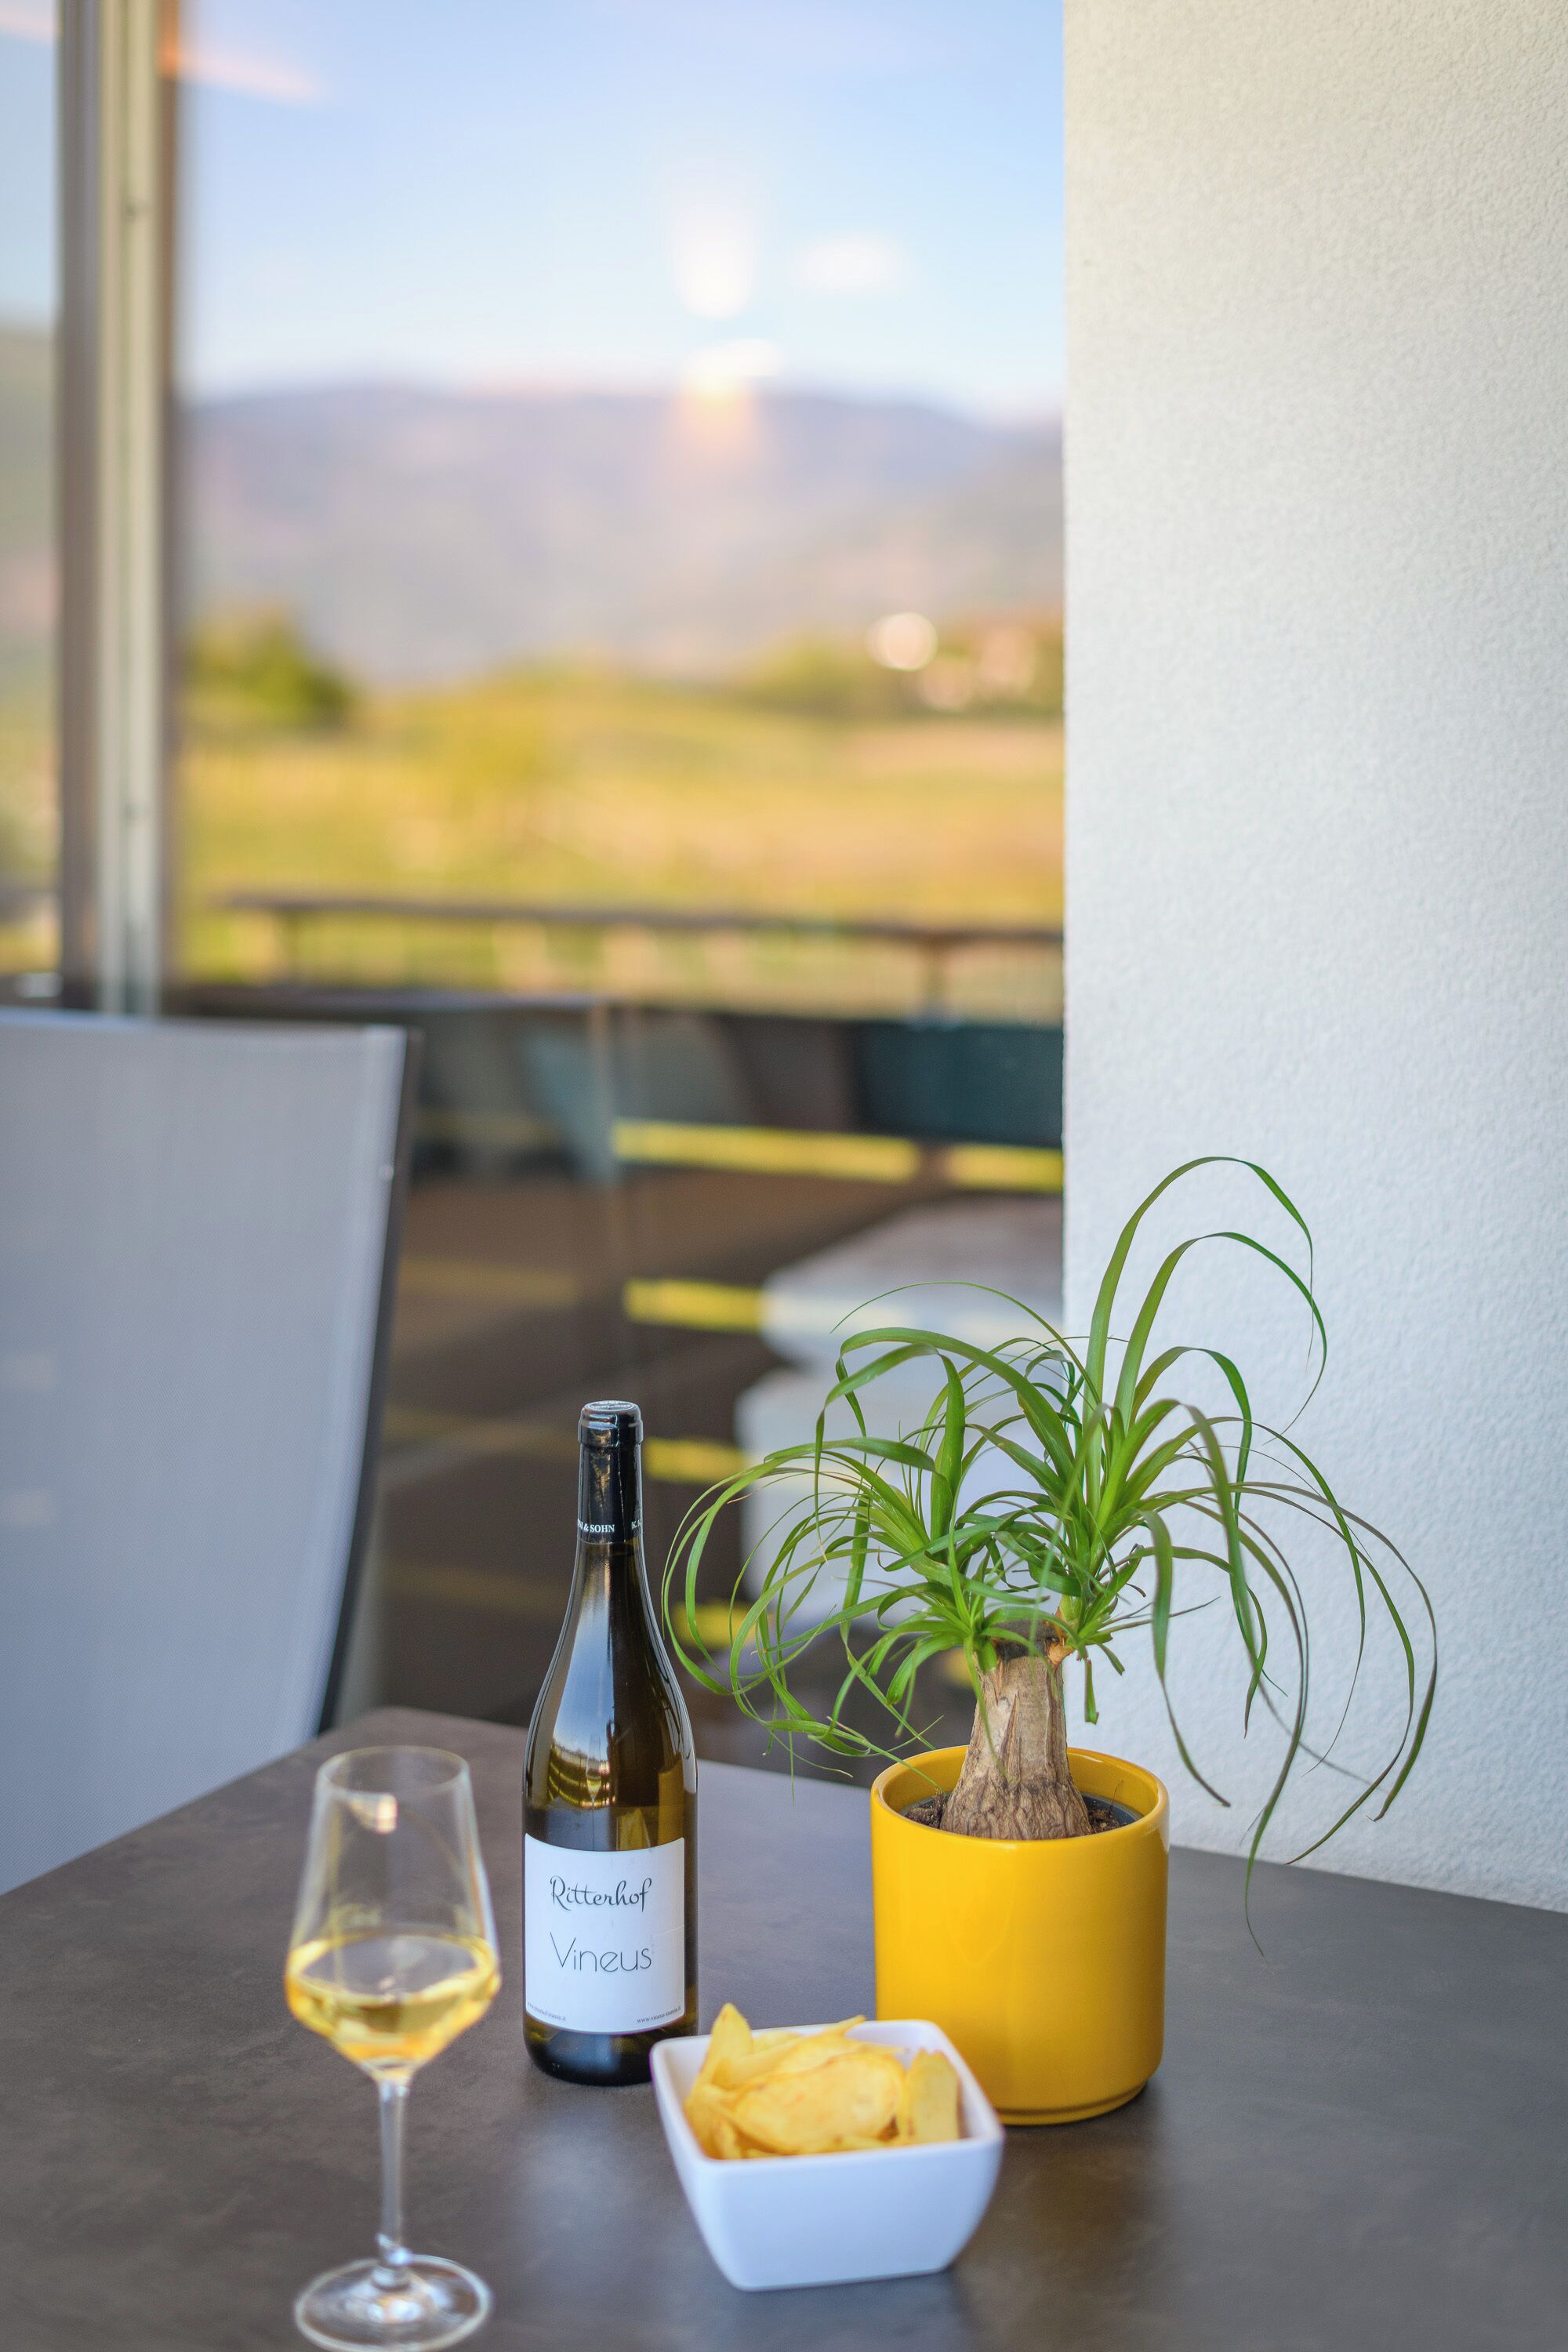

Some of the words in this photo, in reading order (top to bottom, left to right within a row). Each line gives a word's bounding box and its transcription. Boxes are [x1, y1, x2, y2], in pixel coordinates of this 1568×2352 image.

[583, 1523, 590, 1531] &
[590, 1524, 615, 1533] SOHN
[550, 1875, 652, 1913] Ritterhof
[550, 1932, 652, 1973] Vineus
